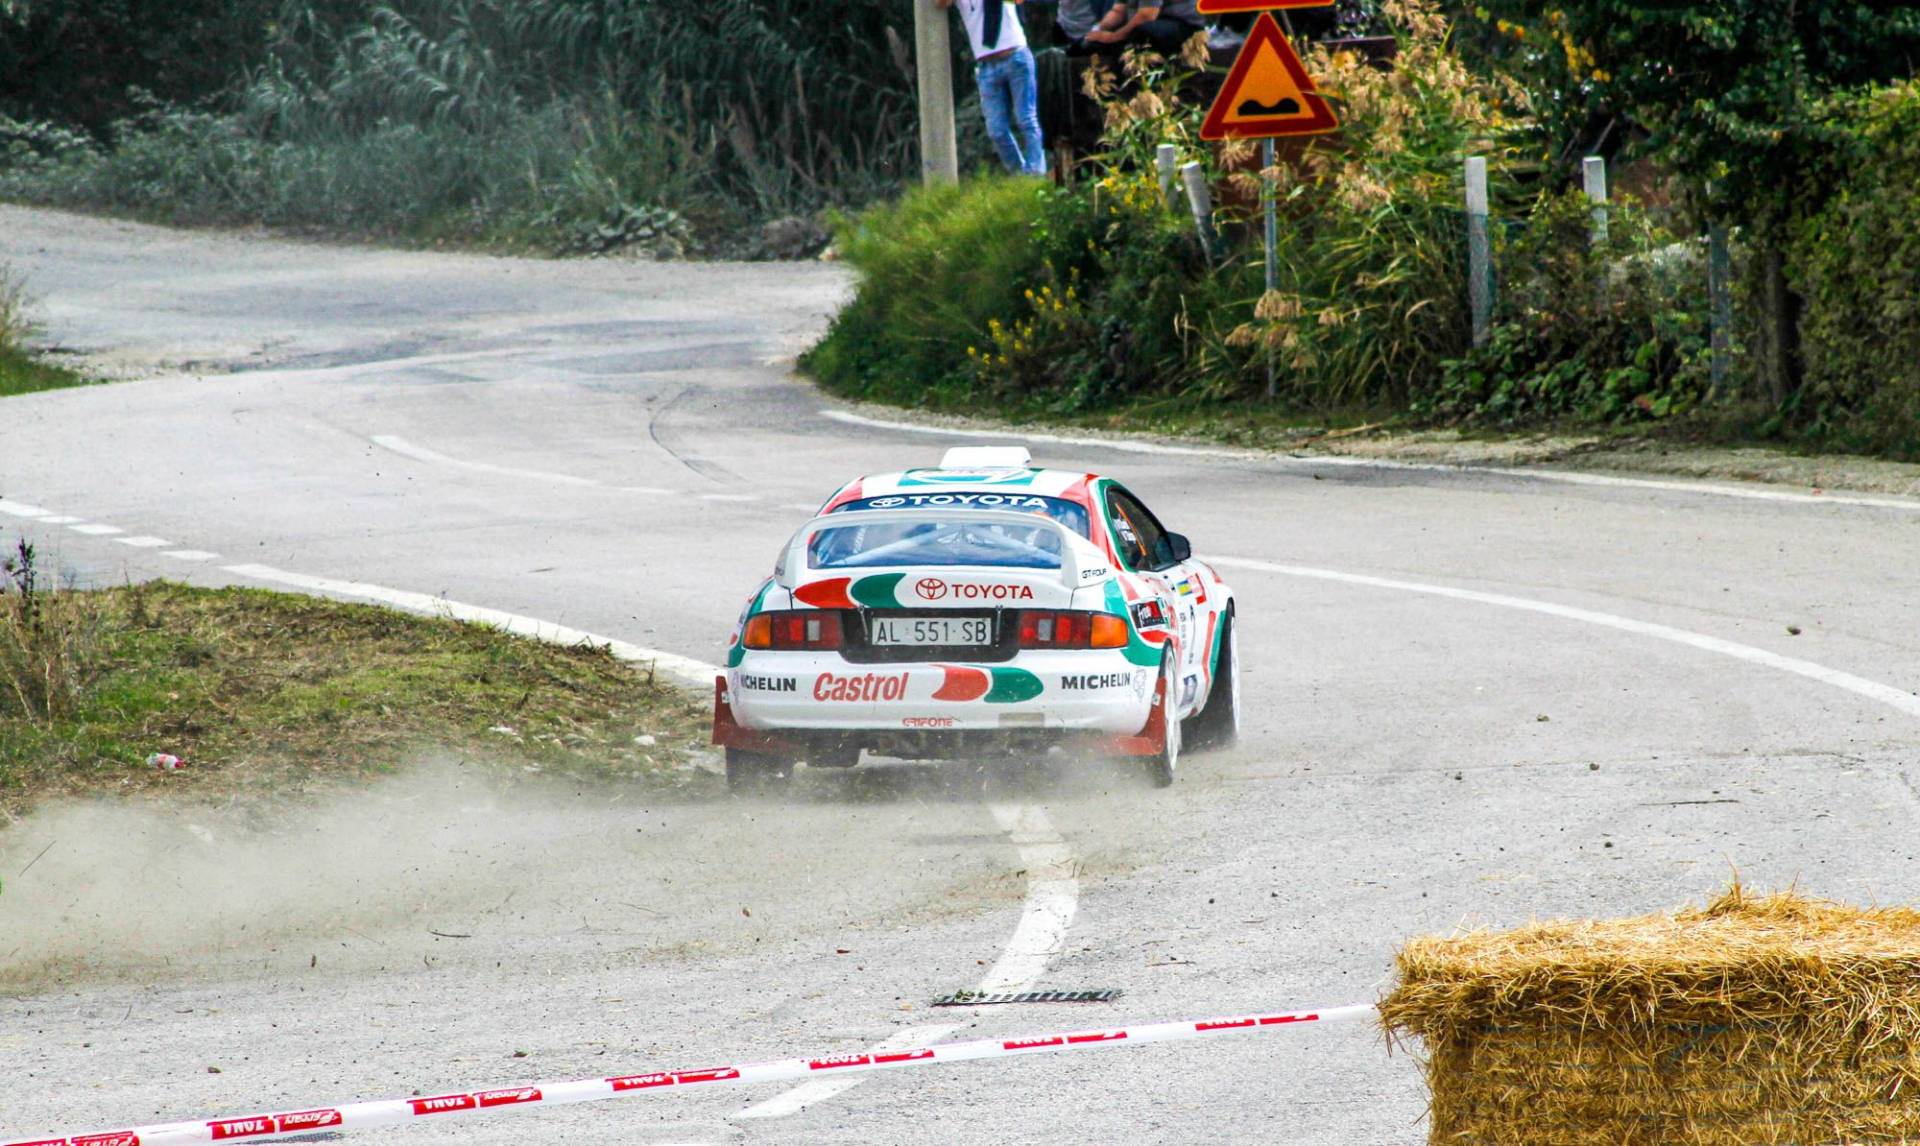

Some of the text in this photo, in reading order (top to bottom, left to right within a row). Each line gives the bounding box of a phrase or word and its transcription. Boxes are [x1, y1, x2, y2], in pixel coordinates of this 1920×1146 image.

[909, 494, 1049, 508] TOYOTA
[951, 584, 1033, 599] TOYOTA
[877, 621, 986, 642] AL 551 SB
[813, 672, 909, 701] Castrol
[1062, 672, 1130, 689] MICHELIN
